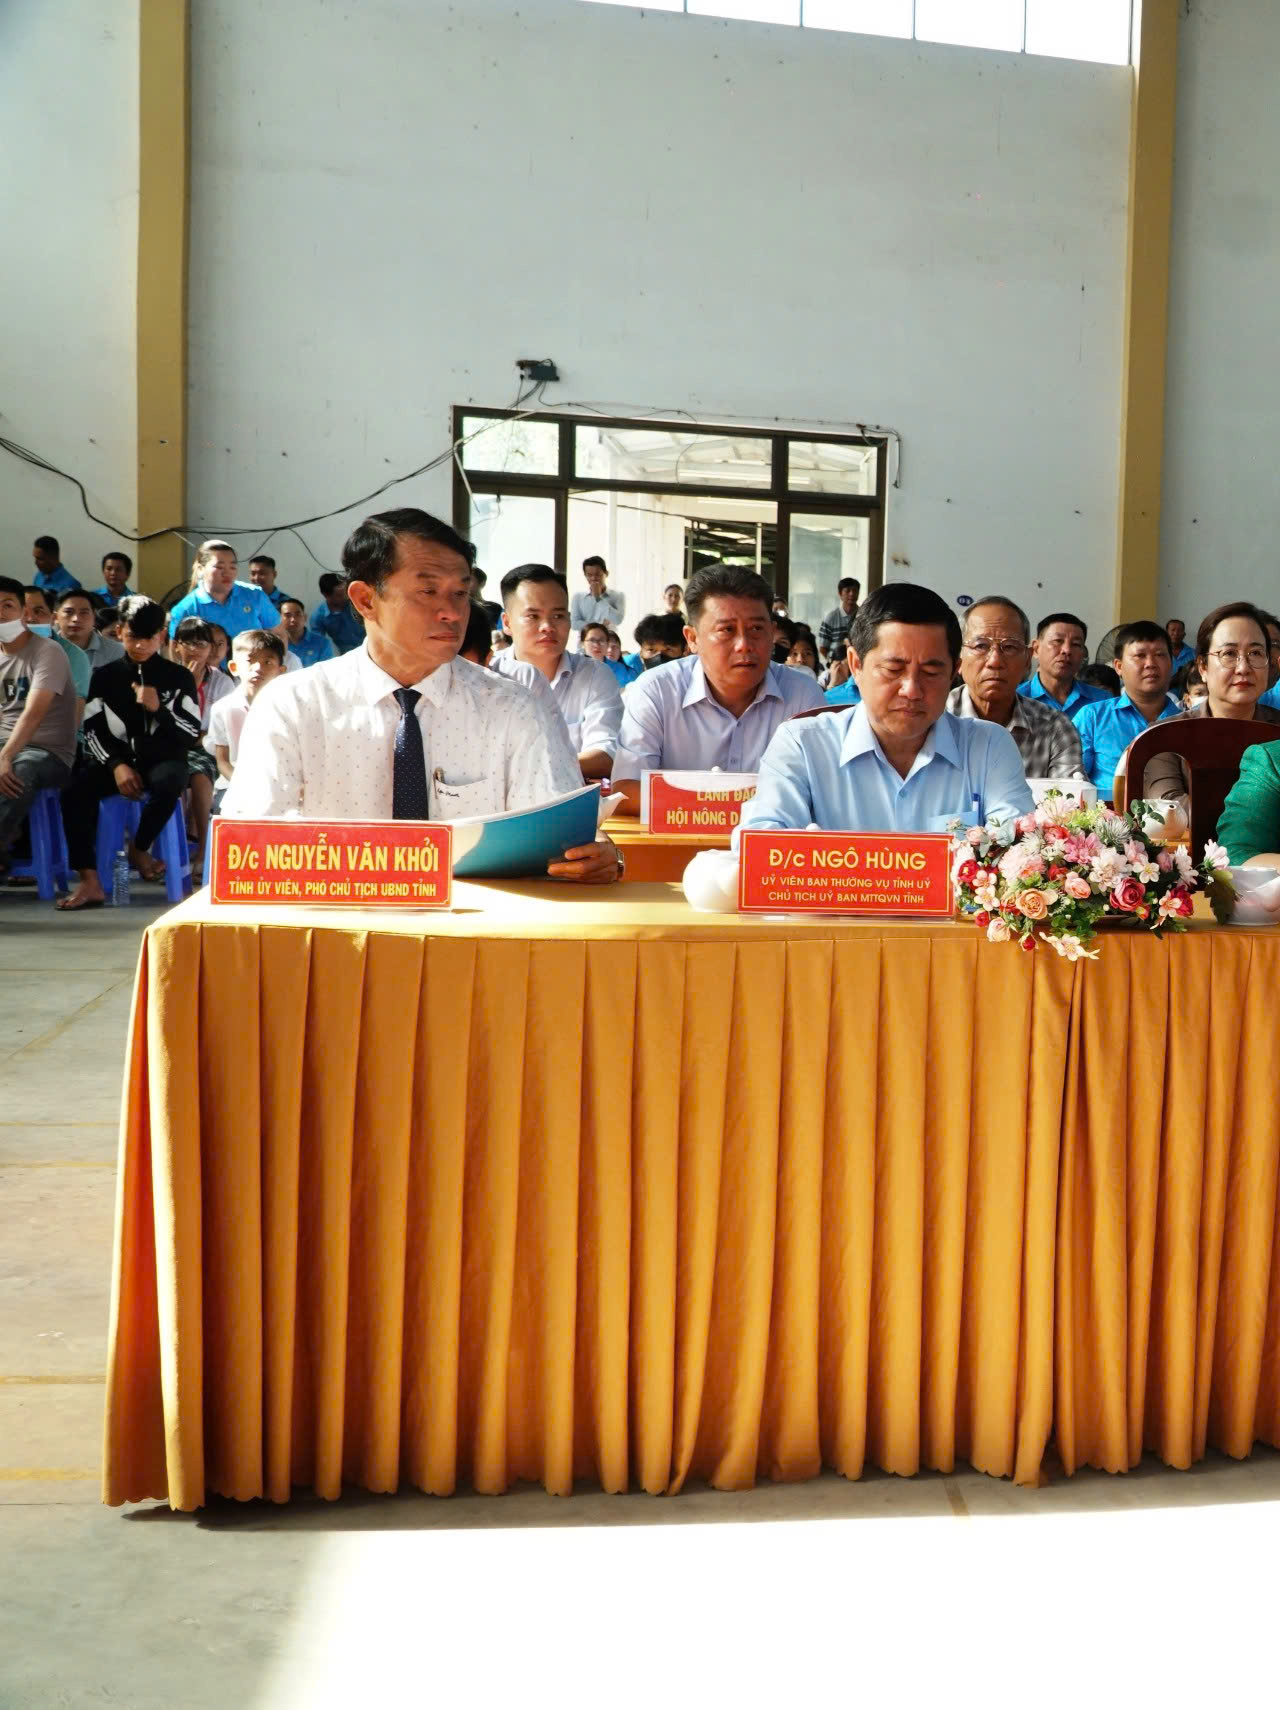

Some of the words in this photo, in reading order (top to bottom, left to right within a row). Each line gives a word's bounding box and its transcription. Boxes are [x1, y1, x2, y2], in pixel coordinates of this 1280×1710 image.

[666, 807, 688, 828] HỘI
[692, 807, 726, 825] NÔNG
[227, 844, 259, 870] Đ/c
[265, 832, 341, 872] NGUYỄN
[347, 842, 388, 872] VĂN
[394, 836, 439, 872] KHỞI
[768, 848, 806, 870] Đ/c
[812, 846, 859, 870] NGÔ
[866, 846, 927, 870] HÙNG
[228, 876, 254, 895] TỈNH
[257, 876, 272, 895] ỦY
[274, 878, 302, 898] VIÊN,
[305, 878, 327, 896] PHÓ
[330, 878, 351, 896] CHỦ
[354, 882, 378, 898] TỊCH
[380, 882, 410, 897] UBND
[412, 878, 437, 897] TỈNH
[780, 875, 804, 886] VIÊN
[807, 877, 828, 887] BAN
[832, 876, 872, 888] THƯỜNG
[875, 879, 890, 890] VỤ
[893, 876, 914, 889] TỈNH
[768, 888, 791, 901] CHỦ
[794, 892, 816, 902] TỊCH
[837, 893, 858, 902] BAN
[860, 894, 900, 903] MTTQVN
[903, 892, 924, 904] TỈNH
